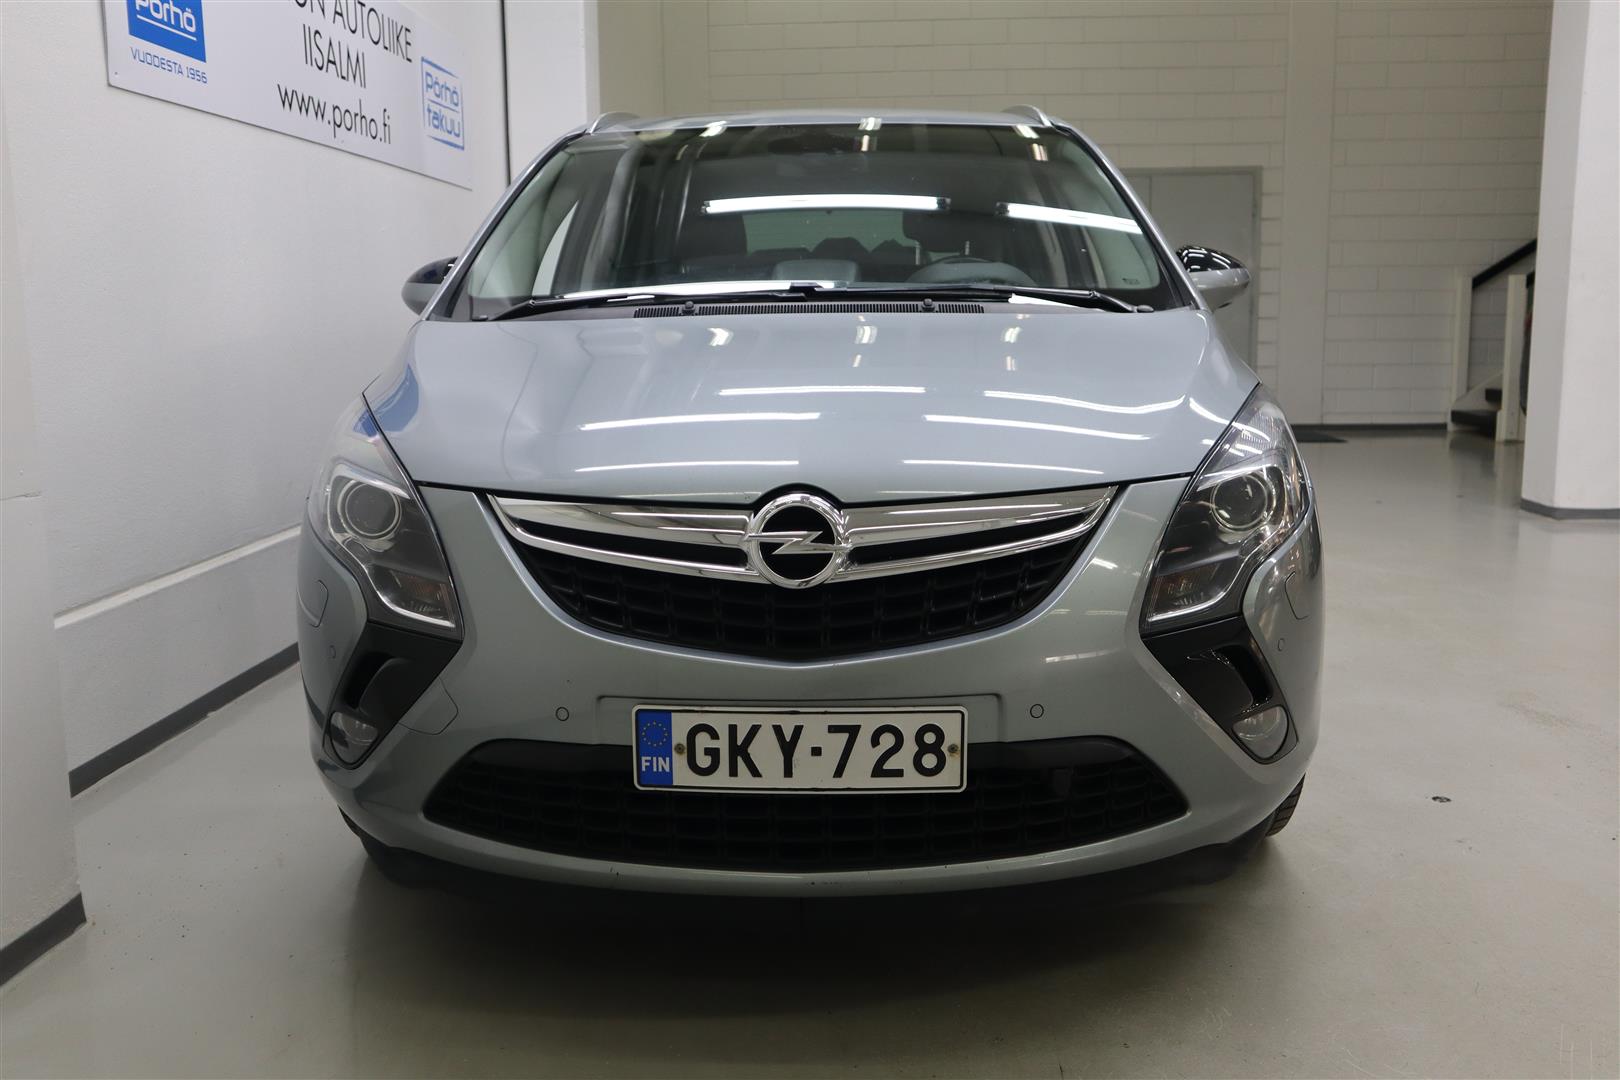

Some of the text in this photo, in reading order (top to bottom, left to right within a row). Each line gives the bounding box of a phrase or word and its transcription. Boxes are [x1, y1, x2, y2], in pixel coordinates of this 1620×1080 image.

[302, 23, 366, 89] IISALMI
[332, 0, 412, 63] AUTOLIIKE
[130, 47, 208, 84] VUODESTA 1956
[277, 83, 391, 145] www.porho.fi
[427, 103, 461, 138] takuu
[641, 756, 671, 773] FIN
[686, 723, 947, 779] GKY-728
